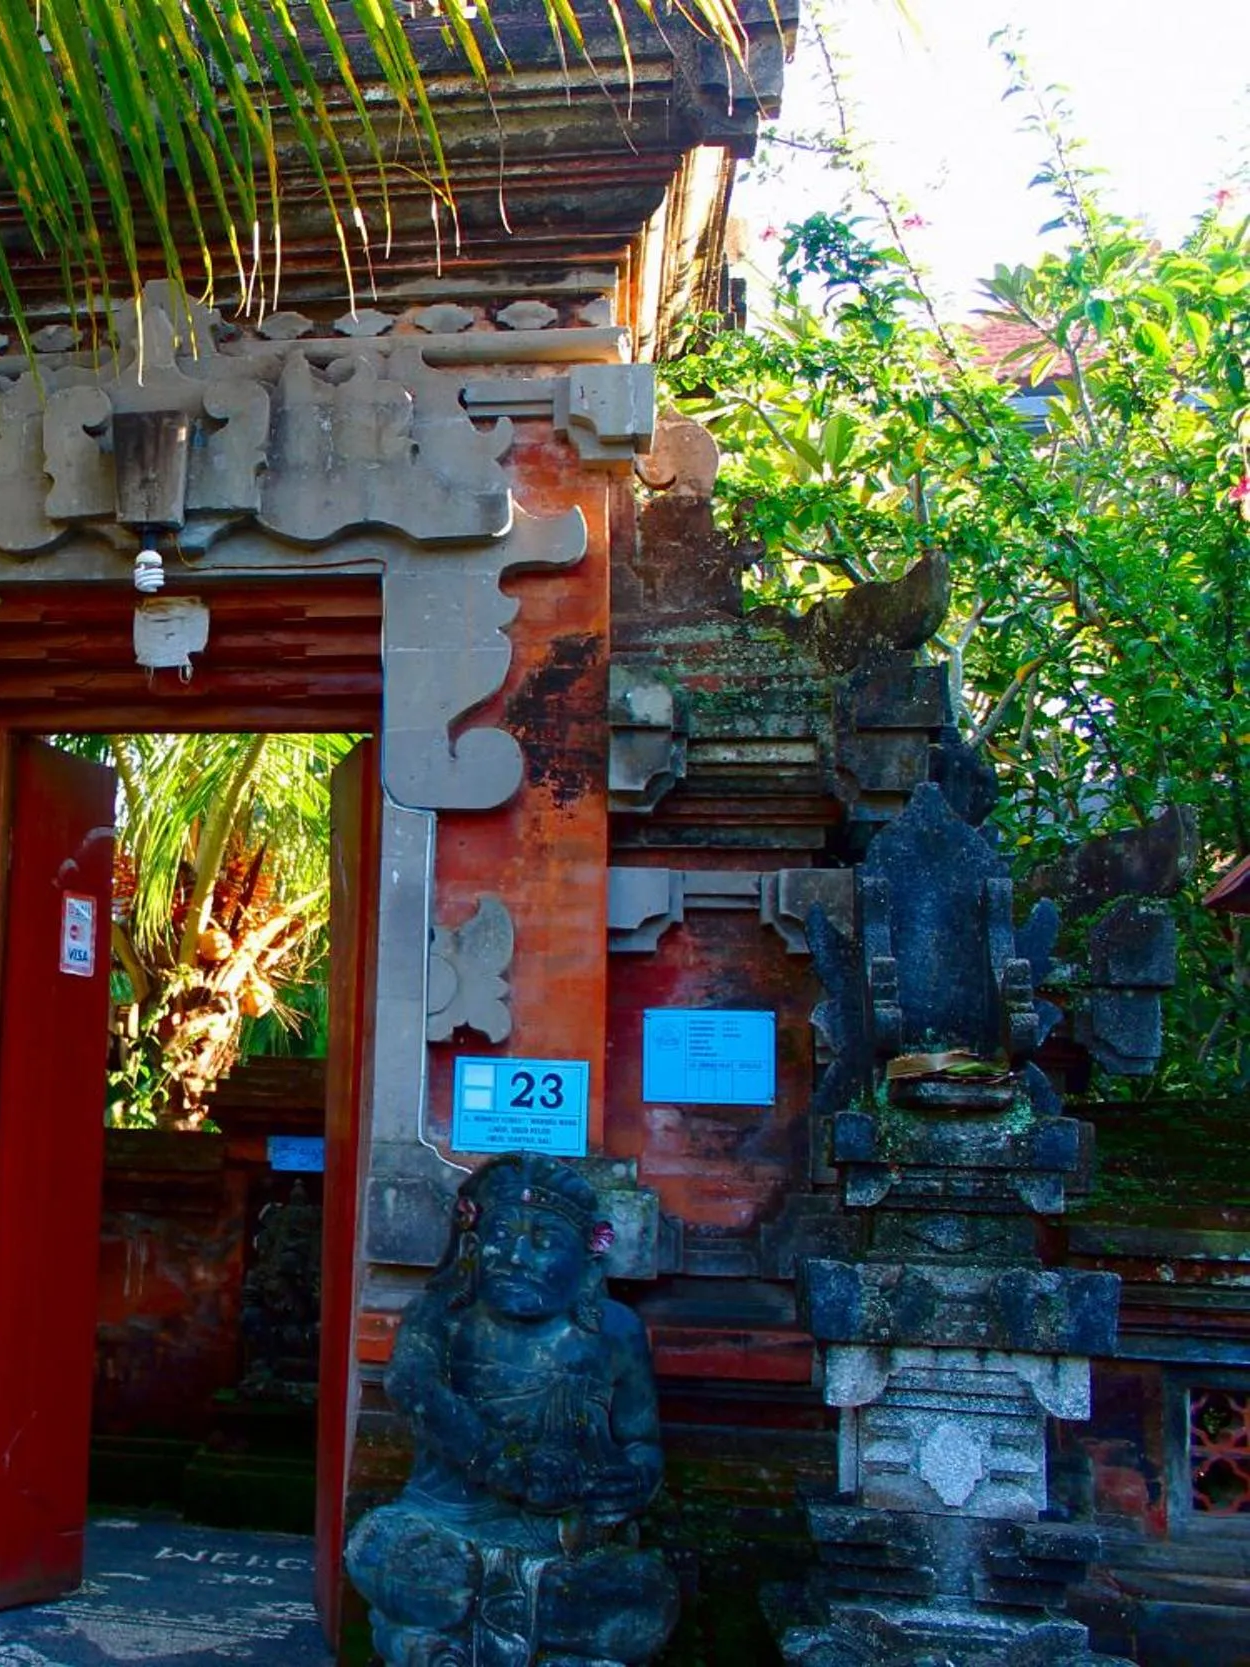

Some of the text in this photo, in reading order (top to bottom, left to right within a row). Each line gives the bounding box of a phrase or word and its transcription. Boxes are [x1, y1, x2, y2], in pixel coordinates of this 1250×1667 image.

[69, 948, 88, 961] VISA
[510, 1071, 564, 1109] 23
[154, 1546, 316, 1572] WELC
